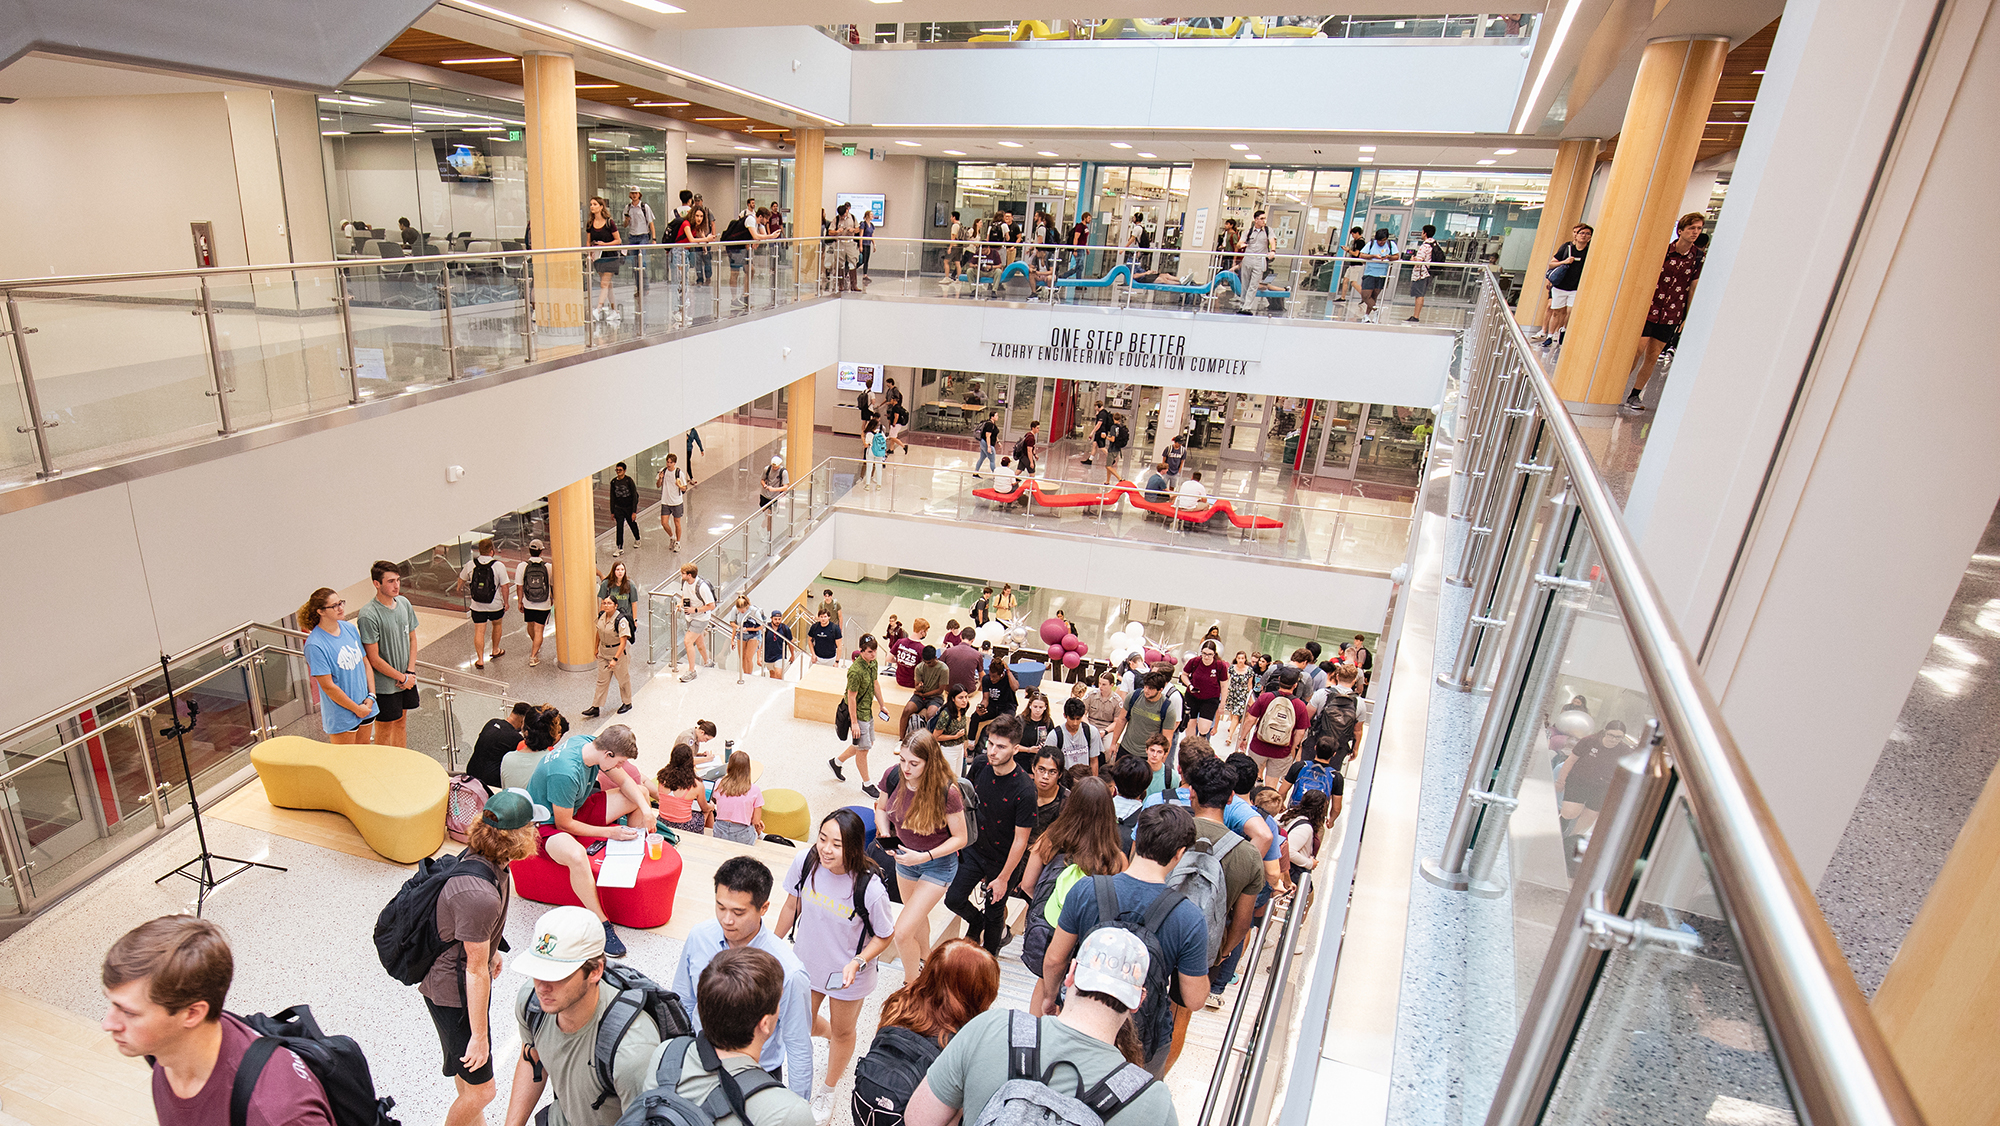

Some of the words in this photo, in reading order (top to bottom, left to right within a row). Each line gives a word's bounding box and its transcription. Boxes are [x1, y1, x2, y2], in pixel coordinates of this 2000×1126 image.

[1051, 327, 1081, 349] ONE
[1086, 329, 1123, 352] STEP
[1128, 332, 1186, 356] BETTER
[990, 342, 1034, 360] ZACHRY
[1037, 345, 1114, 366] ENGINEERING
[1119, 351, 1186, 371] EDUCATION
[1190, 356, 1248, 376] COMPLEX
[897, 650, 916, 663] 2025
[808, 889, 834, 908] BETA
